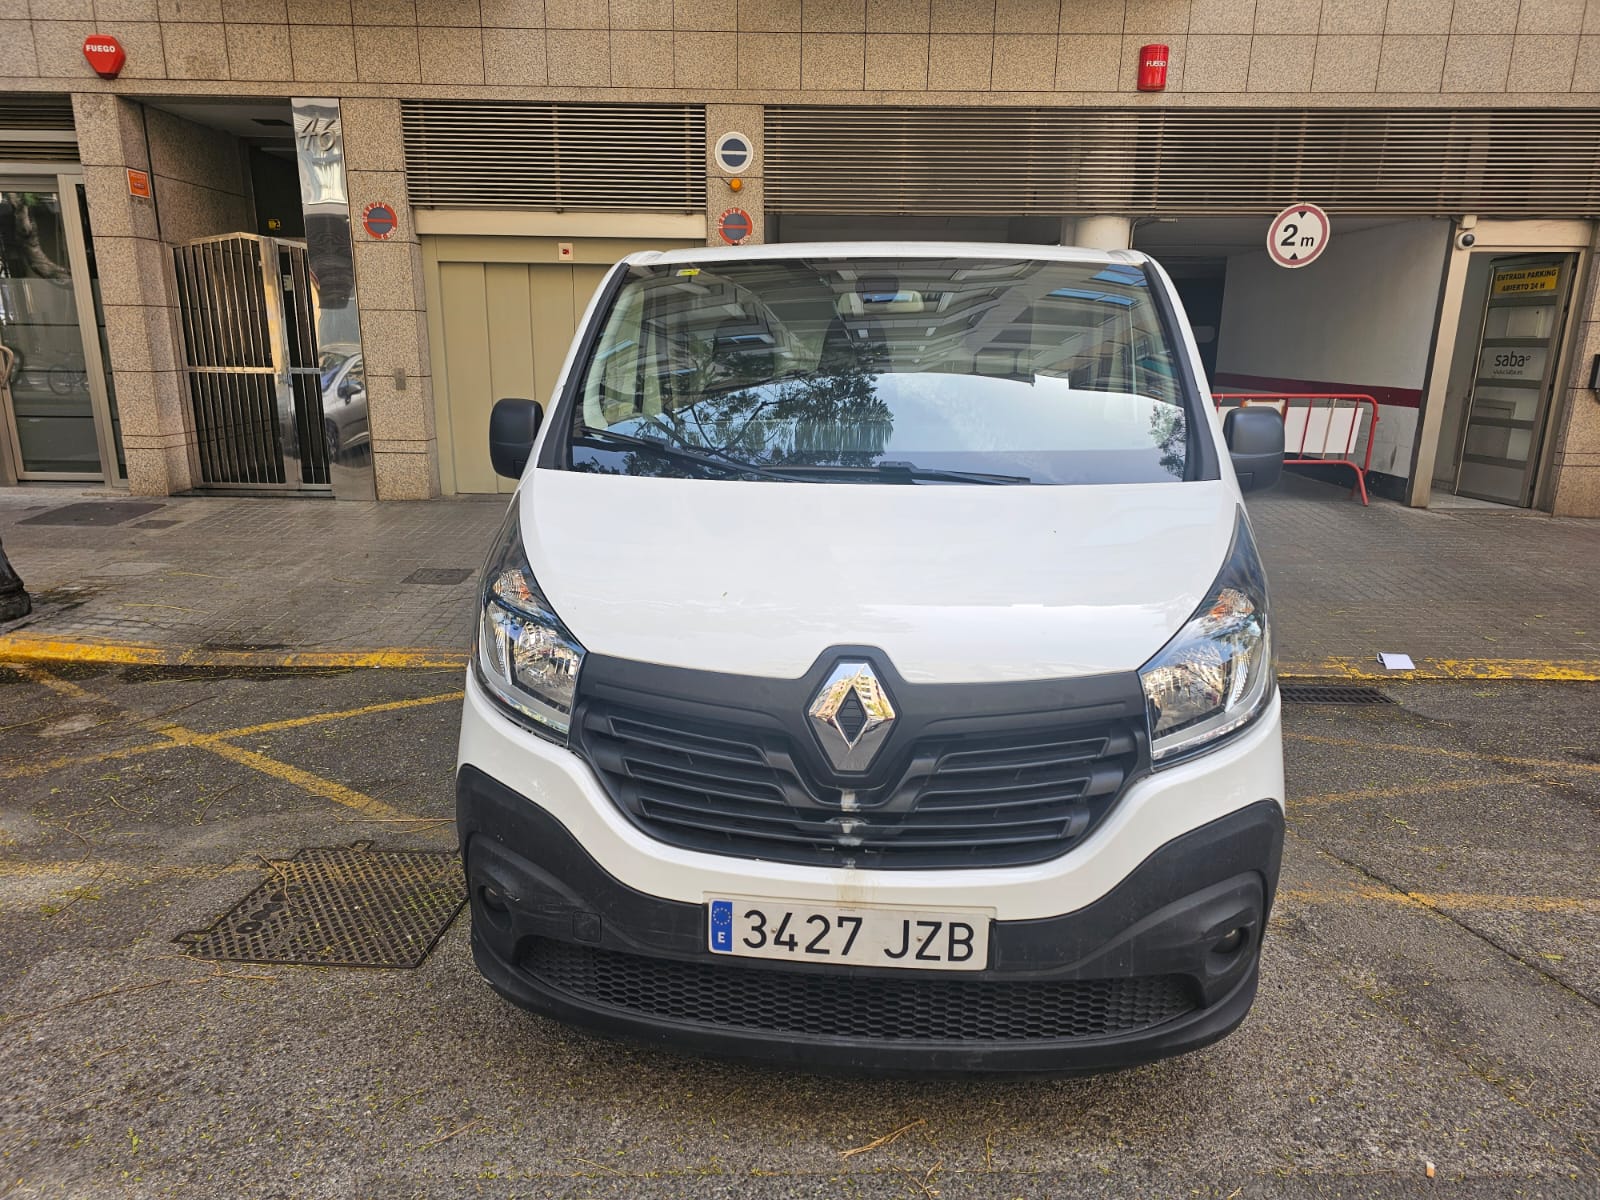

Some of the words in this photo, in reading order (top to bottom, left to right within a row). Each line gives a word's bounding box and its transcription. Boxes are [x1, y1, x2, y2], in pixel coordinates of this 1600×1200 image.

[85, 44, 116, 53] FUEGO
[299, 115, 336, 151] 46
[1281, 223, 1298, 246] 2
[1300, 236, 1314, 247] m
[1496, 272, 1526, 281] ENTRADA
[1527, 269, 1557, 279] PARKING
[1502, 283, 1529, 291] ABIERTO
[1530, 282, 1539, 290] 24
[1494, 350, 1525, 367] saba
[717, 931, 726, 943] E
[742, 909, 863, 956] 3427
[883, 919, 974, 962] JZB
